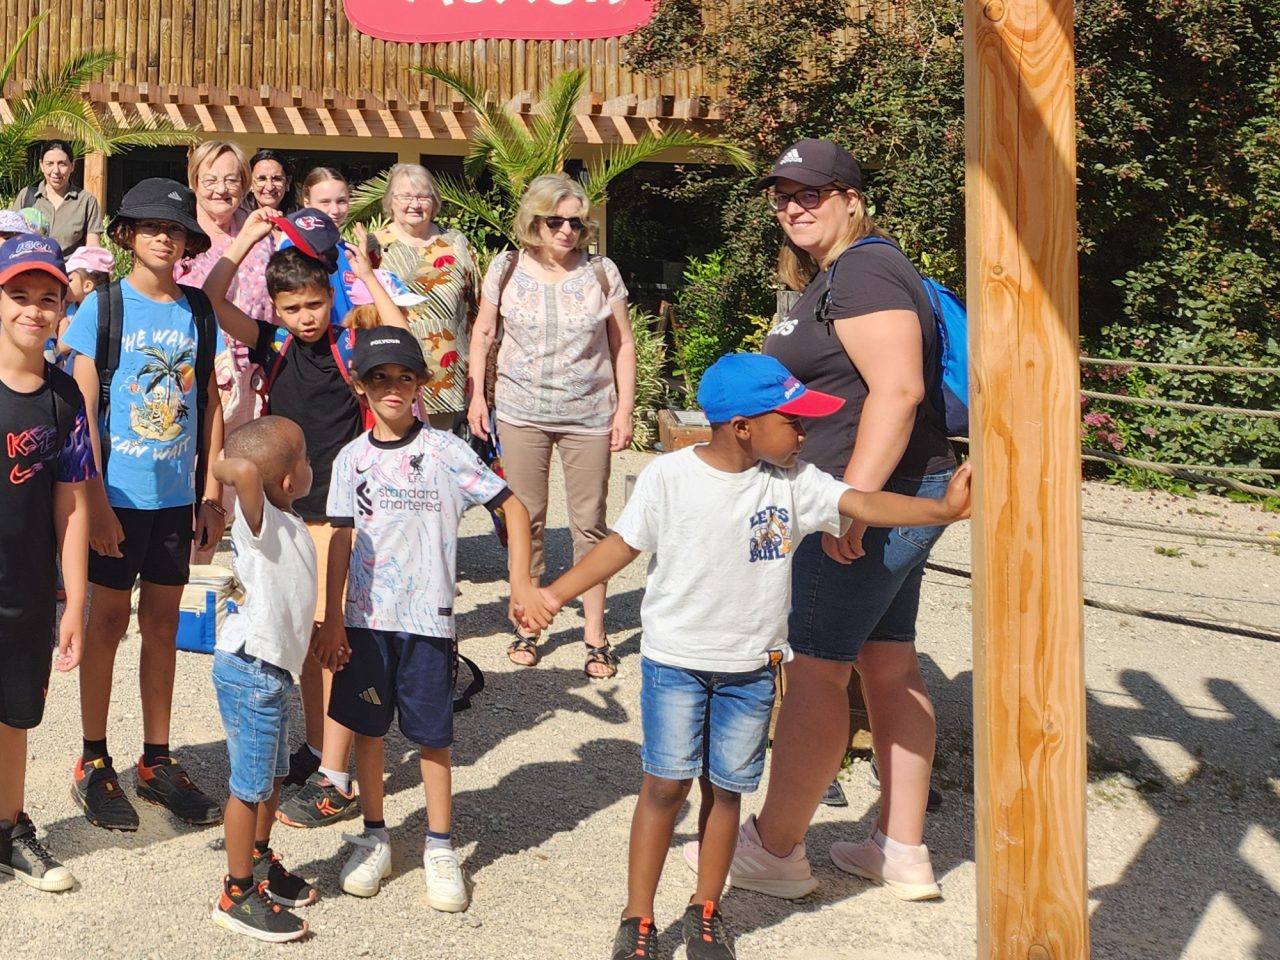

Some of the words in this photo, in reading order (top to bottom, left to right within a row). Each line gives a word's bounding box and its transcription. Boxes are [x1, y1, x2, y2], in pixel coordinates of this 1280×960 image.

[152, 434, 192, 461] WAIT
[379, 486, 439, 500] standard
[379, 500, 442, 513] chartered
